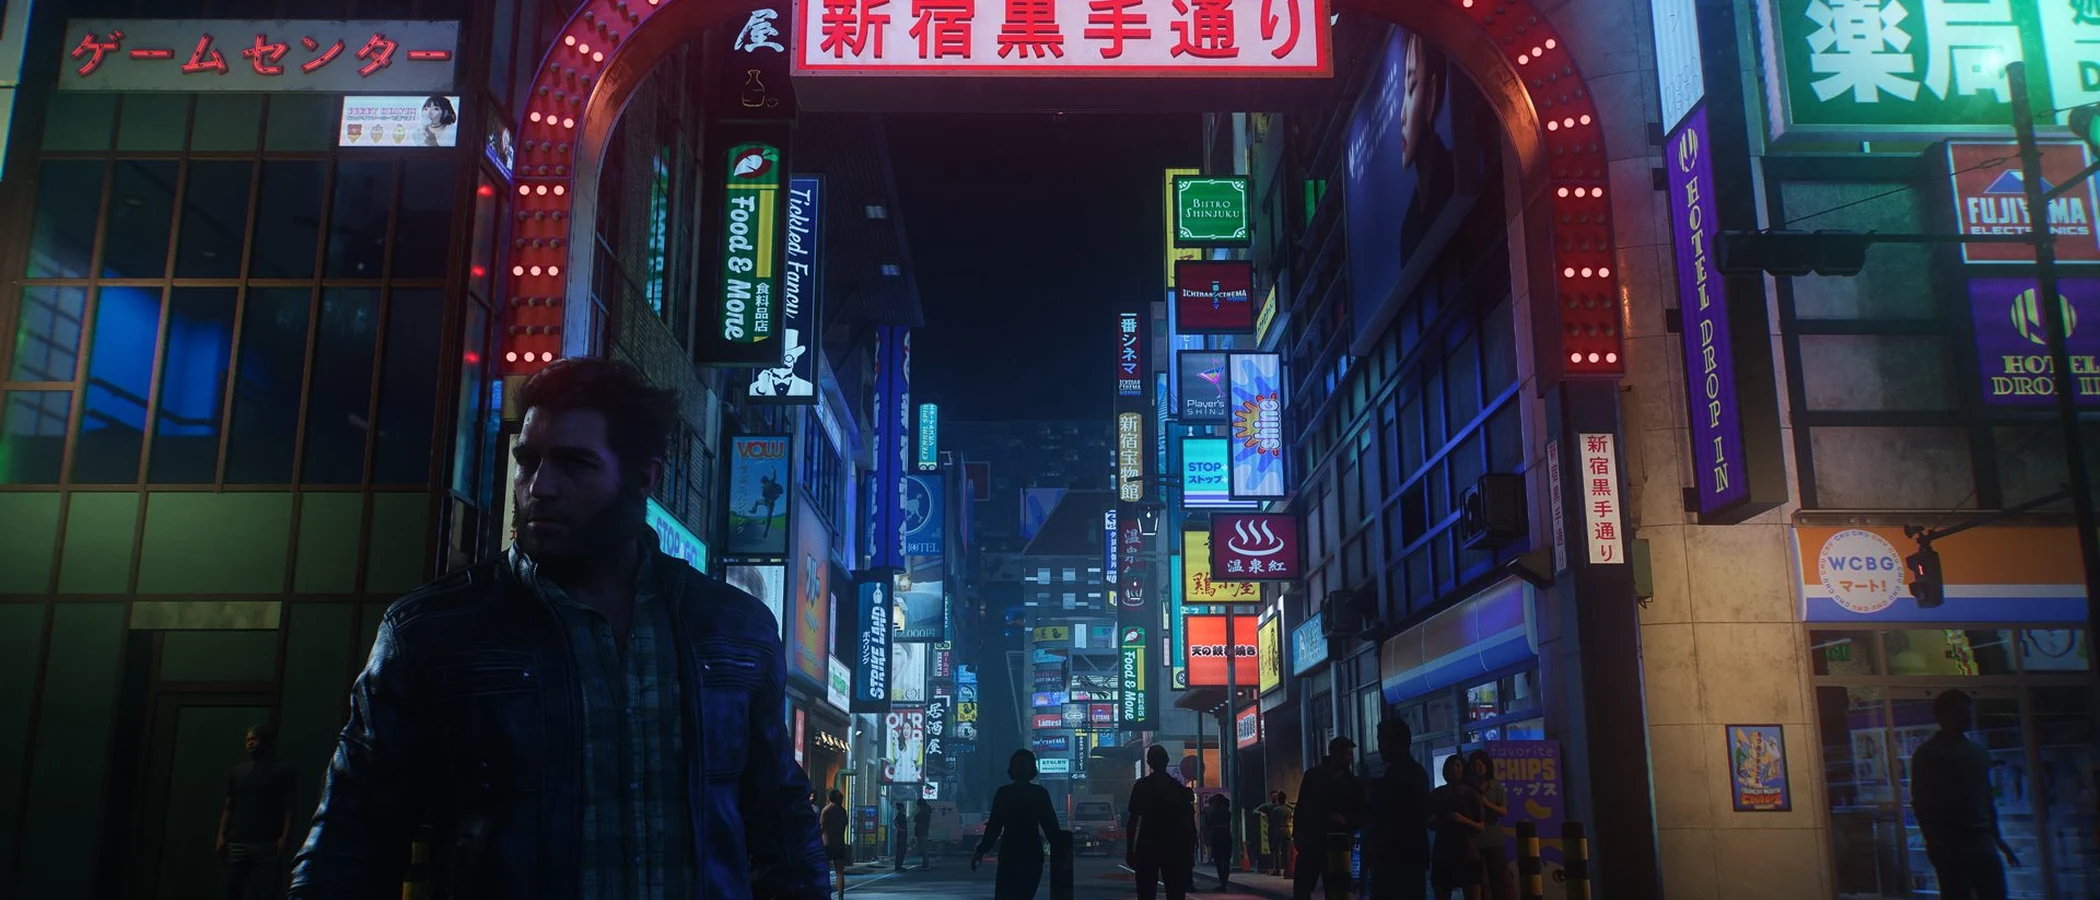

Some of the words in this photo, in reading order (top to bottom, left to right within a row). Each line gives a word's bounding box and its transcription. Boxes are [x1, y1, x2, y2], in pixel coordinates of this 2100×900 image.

[735, 9, 784, 52] 屋
[820, 0, 1300, 59] 新宿黒手通り
[71, 30, 453, 78] ゲームセンター
[1805, 0, 2024, 103] 薬局
[729, 196, 755, 252] Food
[788, 189, 811, 257] Tickled
[1186, 207, 1240, 219] SHINJUKU
[1967, 197, 2087, 224] FUJIYMA
[728, 256, 753, 274] &
[724, 278, 751, 341] More
[754, 282, 769, 333] 食料品店
[1120, 313, 1137, 374] 一番シネマ
[1686, 177, 1710, 311] HOTEL
[1700, 320, 1722, 428] DROP
[1714, 437, 1729, 493] IN
[1991, 376, 2060, 395] DRO
[1187, 399, 1225, 409] Player's
[1253, 400, 1282, 450] shine
[737, 440, 785, 460] VOW
[1119, 416, 1140, 500] 新宿宝物館
[1188, 462, 1222, 472] STOP
[1188, 475, 1222, 484] ストップ
[1586, 434, 1616, 563] 新宿黒手通り
[1226, 559, 1287, 574] 温泉紅
[1828, 556, 1895, 571] WCBG
[871, 606, 887, 644] LAND
[862, 631, 871, 665] ボウリング
[1124, 651, 1136, 679] Food
[869, 646, 886, 700] STRIKE
[1124, 681, 1136, 689] &
[1124, 691, 1136, 720] More
[926, 702, 943, 755] 居酒屋
[1491, 745, 1554, 757] favorite
[1492, 758, 1556, 781] CHIPS
